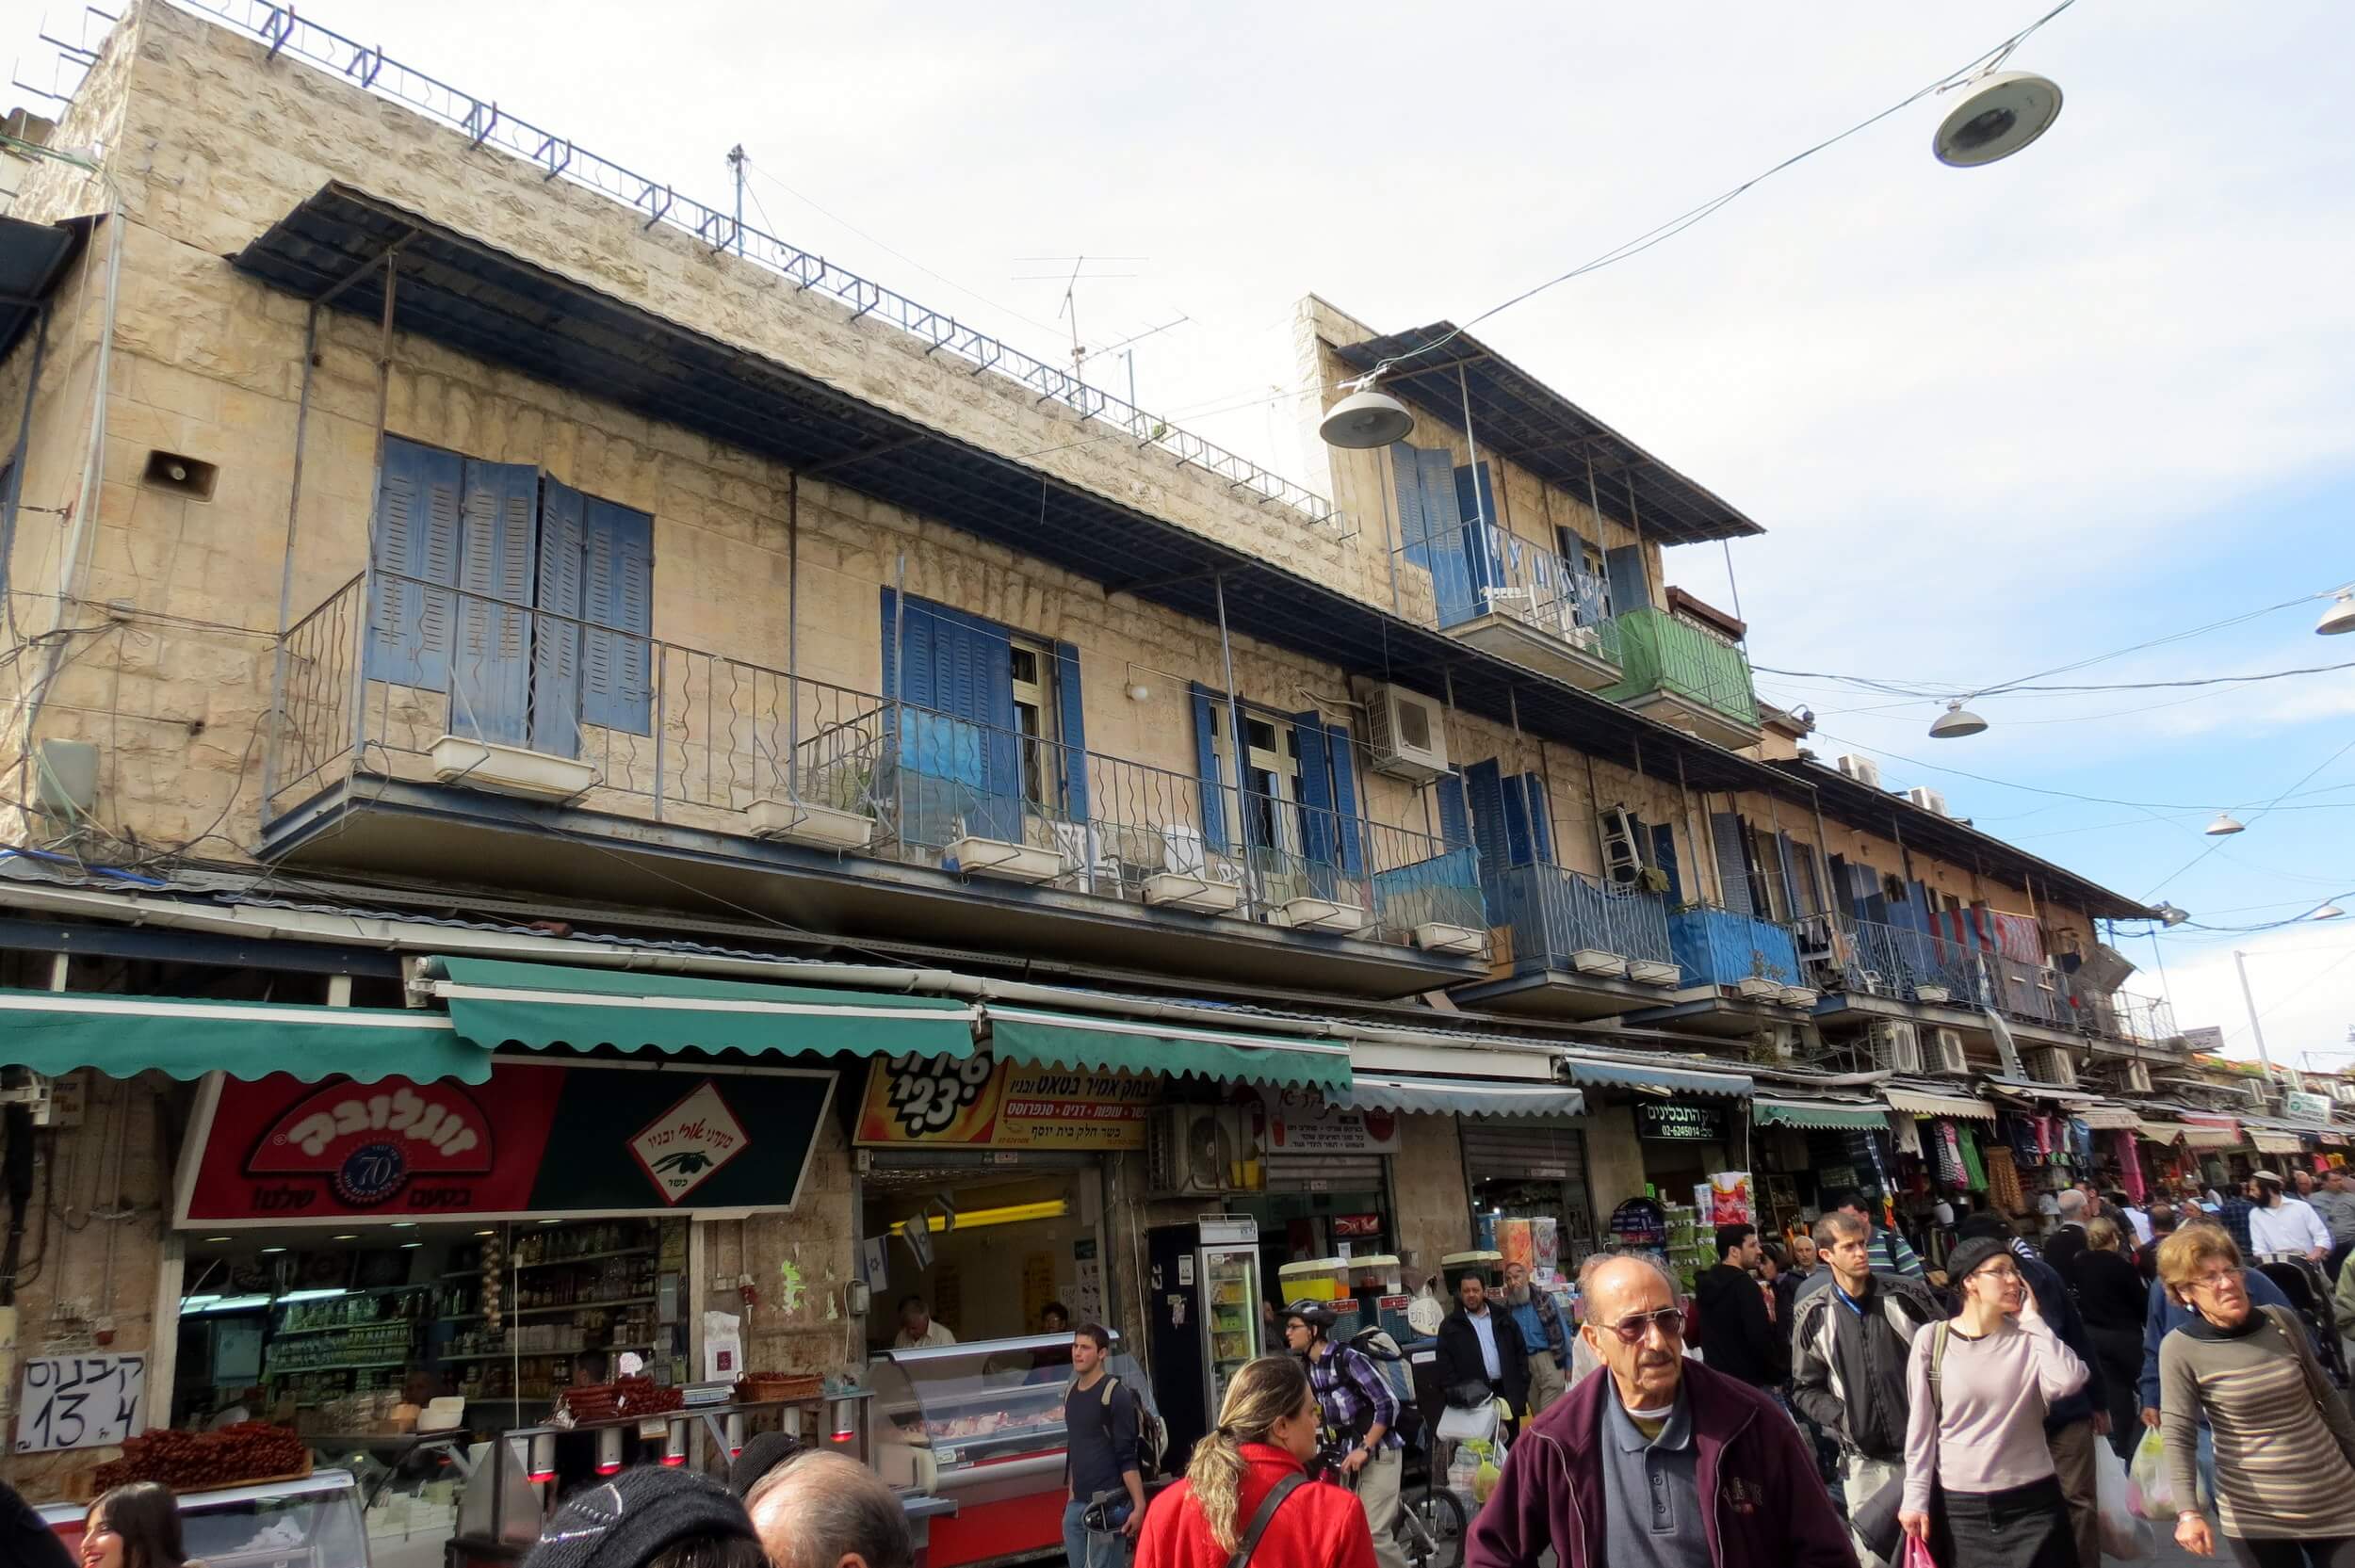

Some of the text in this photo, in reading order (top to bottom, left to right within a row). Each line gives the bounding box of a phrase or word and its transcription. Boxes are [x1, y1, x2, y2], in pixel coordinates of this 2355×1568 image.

[1009, 1078, 1035, 1093] ובניו
[1036, 1075, 1081, 1095] בטאט
[1086, 1076, 1118, 1097] אמיר
[1007, 1102, 1055, 1116] סנפרוסט
[1062, 1104, 1087, 1117] דגים
[1094, 1106, 1122, 1118] עופות
[1647, 1103, 1701, 1122] התבלינים
[648, 1117, 734, 1150] מעדני אורי ובניו
[1031, 1123, 1121, 1140] כשר חלק בית יוסף
[360, 1156, 392, 1186] 70
[668, 1178, 688, 1188] כשר
[26, 1356, 144, 1394] קבנוס
[34, 1392, 91, 1447] 13
[114, 1395, 138, 1439] 4
